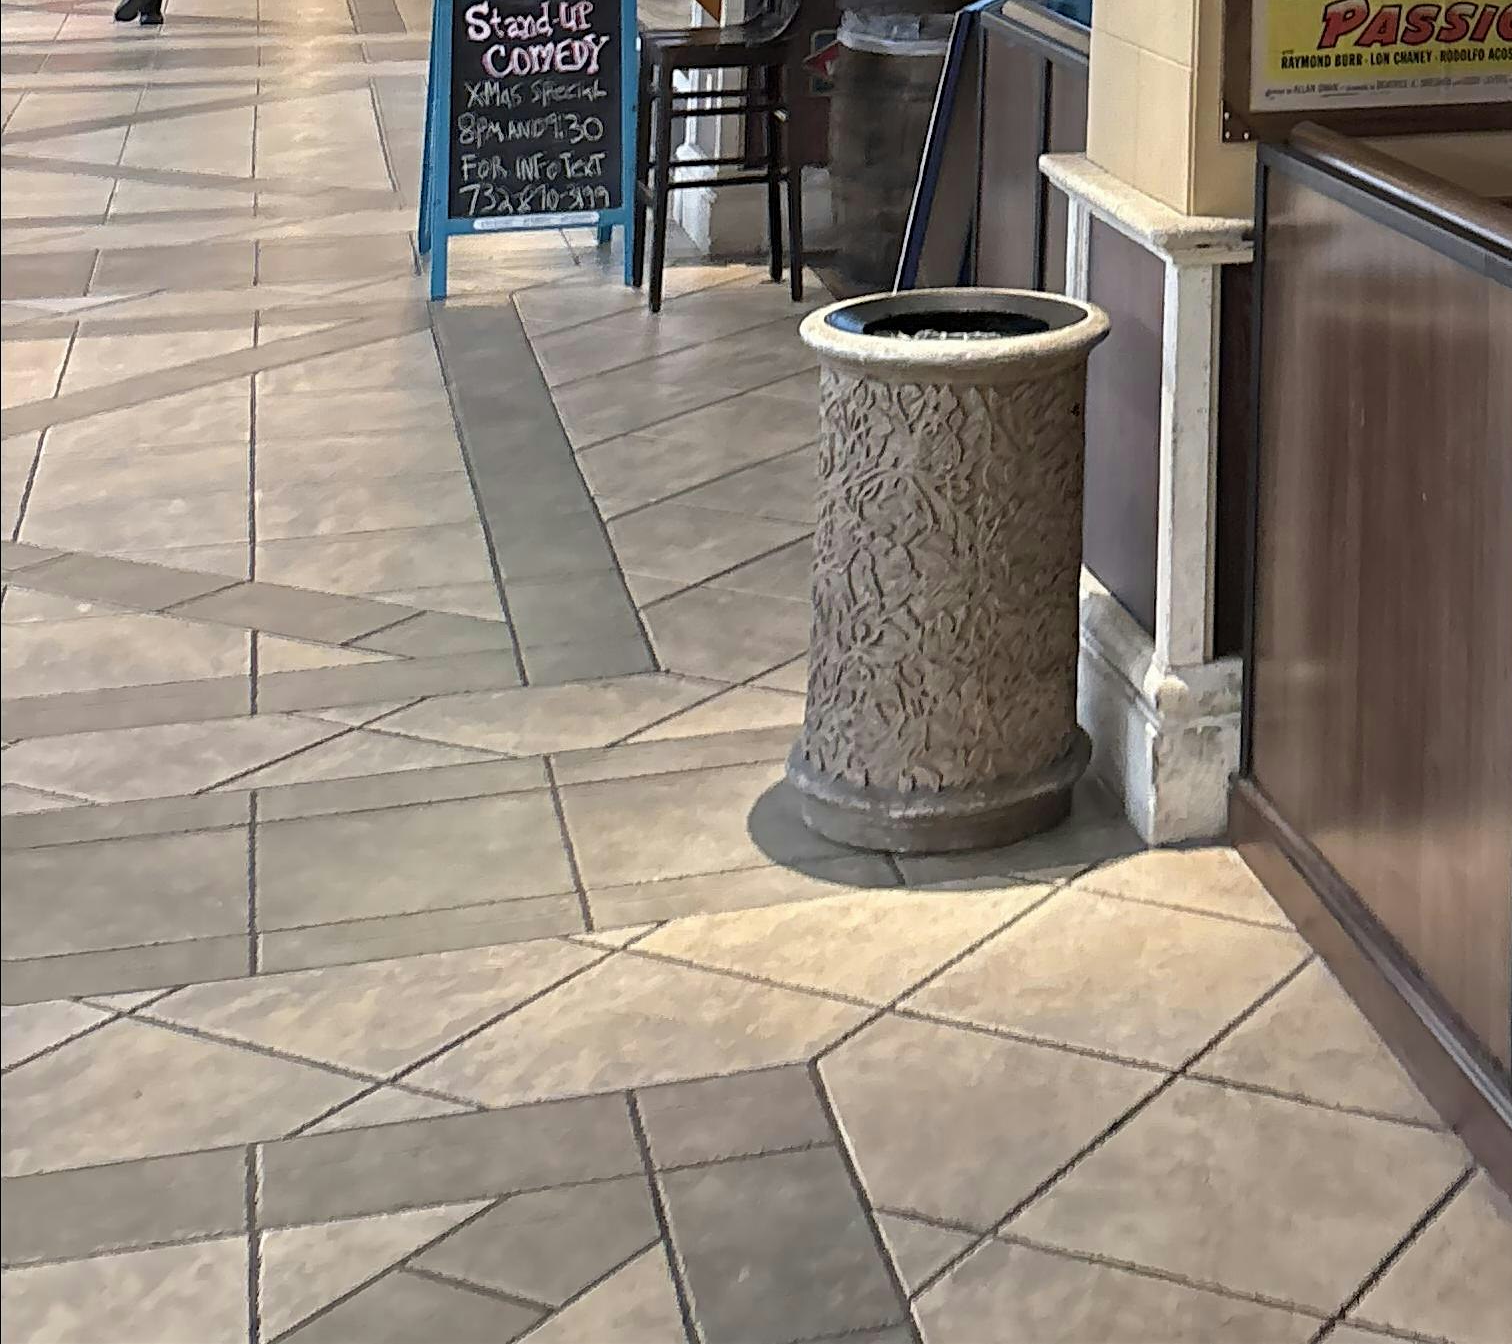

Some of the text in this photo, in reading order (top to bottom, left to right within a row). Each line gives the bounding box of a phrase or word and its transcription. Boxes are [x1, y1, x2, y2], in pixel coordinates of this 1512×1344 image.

[481, 33, 610, 79] COMEDY
[1281, 54, 1331, 70] RAYMOND
[1335, 53, 1363, 68] BURR
[1370, 52, 1390, 66] LON
[1393, 50, 1433, 65] CHANEY
[1440, 48, 1485, 63] RODOLFO
